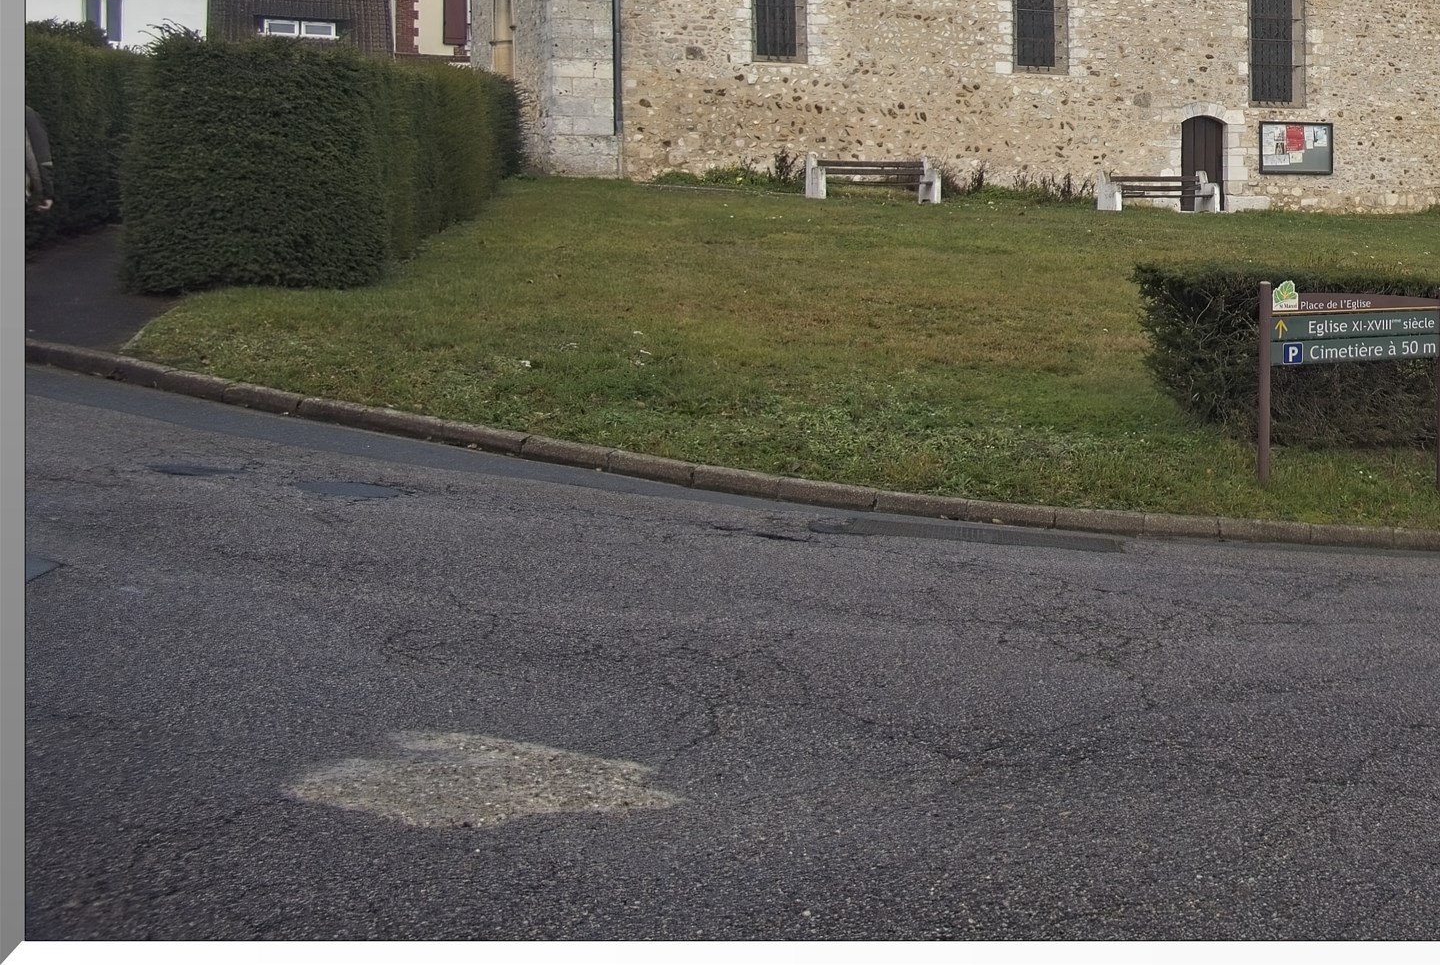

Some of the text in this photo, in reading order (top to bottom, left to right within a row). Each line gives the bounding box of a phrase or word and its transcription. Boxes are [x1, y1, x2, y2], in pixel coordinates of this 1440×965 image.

[1300, 299, 1372, 310] Place de l'Eglise
[1308, 320, 1348, 336] Eglise
[1403, 317, 1435, 329] siècle
[1288, 346, 1299, 362] P
[1310, 340, 1436, 359] Cimetière à 50 m
